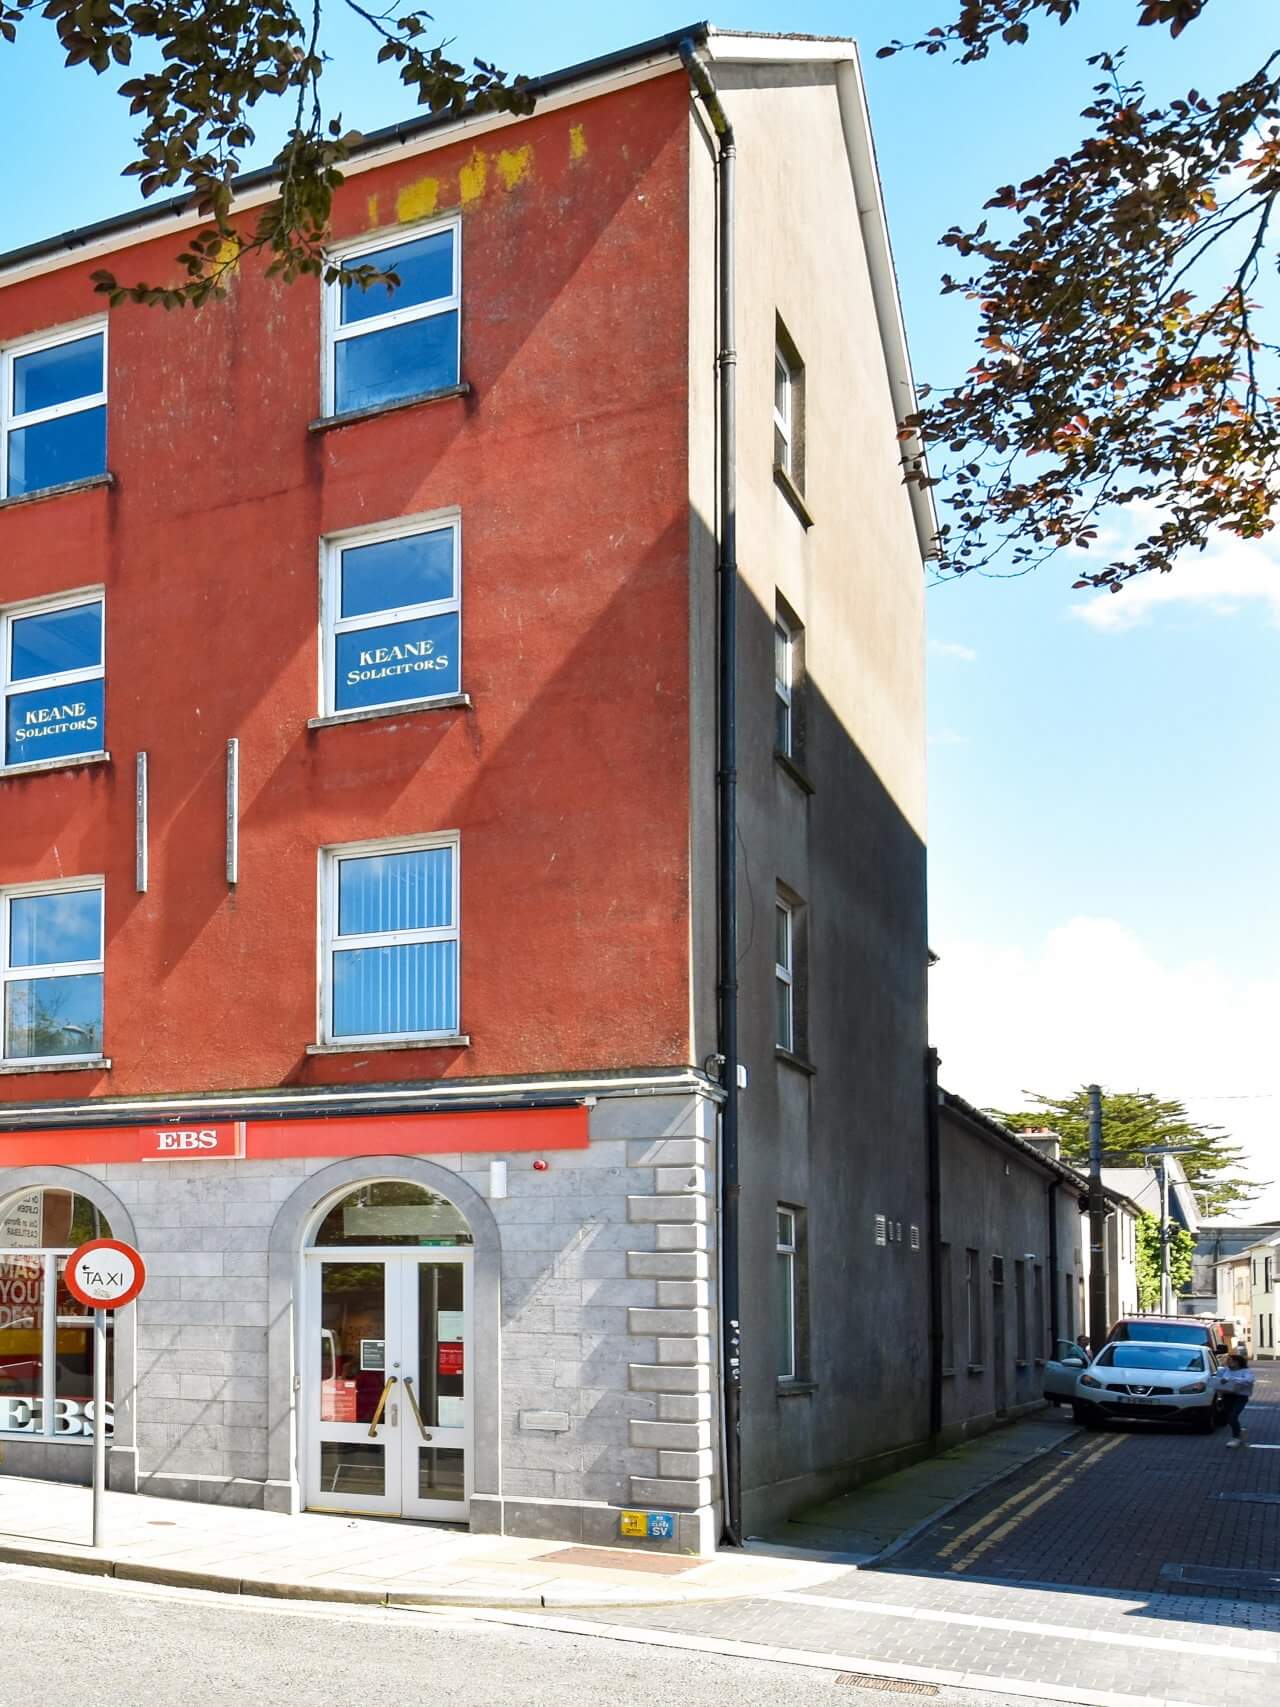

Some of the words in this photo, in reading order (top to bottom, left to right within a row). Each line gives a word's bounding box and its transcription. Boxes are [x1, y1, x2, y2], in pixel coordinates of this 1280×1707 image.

[360, 640, 434, 666] KEANE
[26, 702, 86, 725] KEANE
[157, 1130, 217, 1150] EBS
[83, 1271, 124, 1286] TAXI
[652, 1527, 668, 1536] SV
